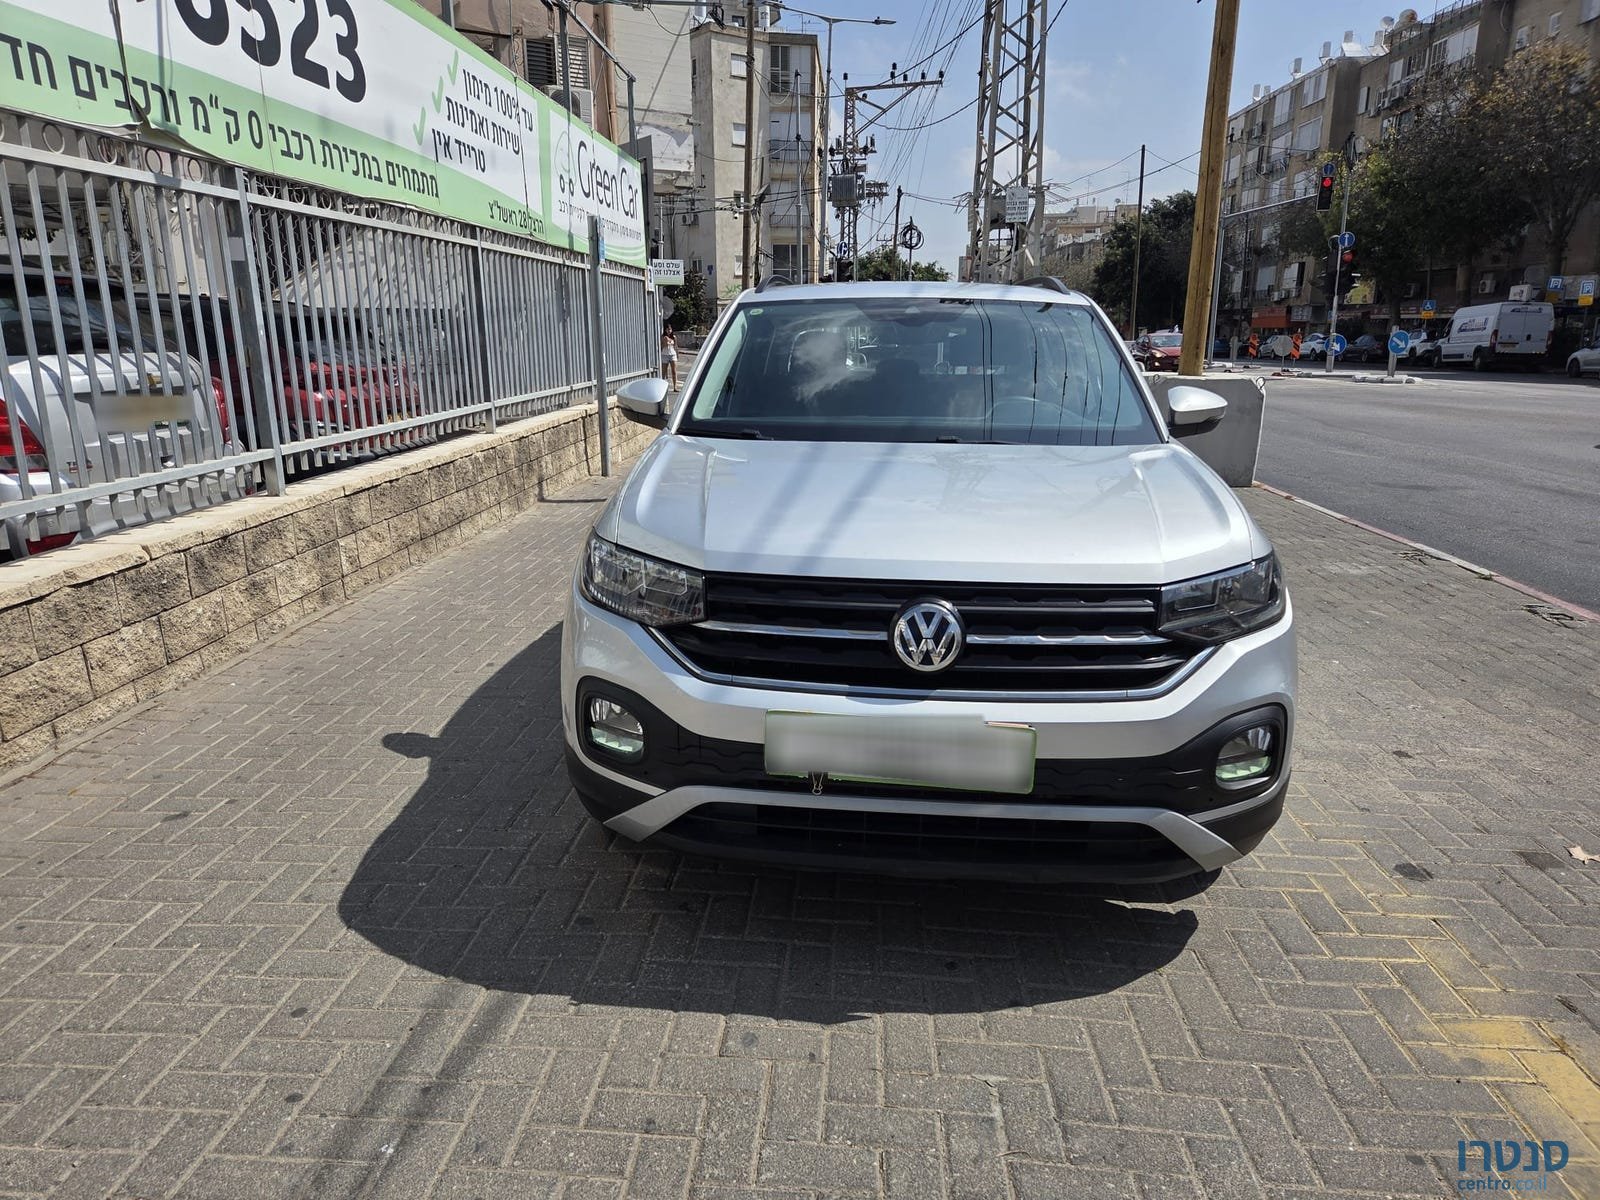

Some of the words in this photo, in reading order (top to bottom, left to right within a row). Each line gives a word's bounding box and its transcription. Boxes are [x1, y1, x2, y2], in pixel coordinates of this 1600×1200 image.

[68, 55, 182, 126] ורכבים
[463, 69, 492, 107] מימון
[494, 86, 520, 124] 100%
[248, 110, 263, 149] 0
[445, 96, 490, 141] ואמינות
[521, 107, 533, 132] עד
[268, 123, 317, 165] רכבי
[432, 128, 453, 163] אין
[455, 138, 486, 173] טרייד
[492, 121, 520, 155] שירות
[320, 138, 383, 183] במכירת
[385, 160, 439, 198] מתמחים
[578, 140, 619, 212] Green
[620, 167, 638, 220] Car
[518, 209, 528, 229] 28
